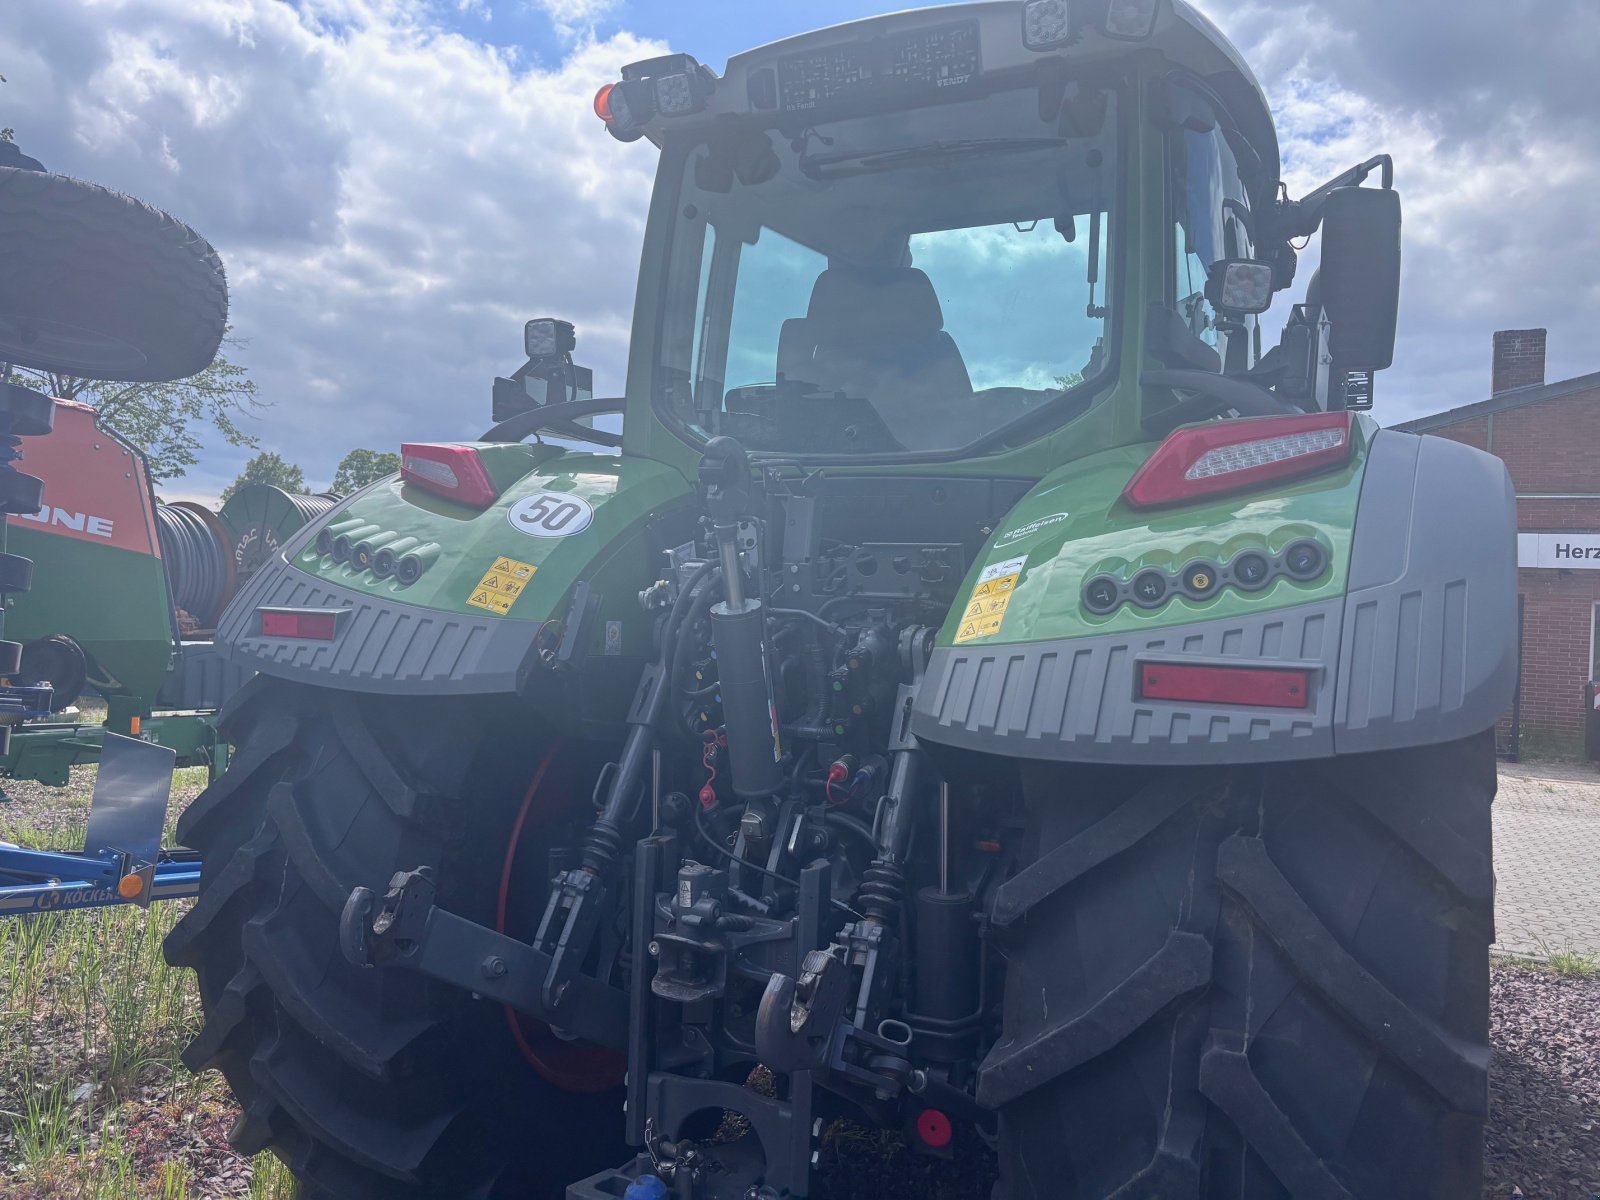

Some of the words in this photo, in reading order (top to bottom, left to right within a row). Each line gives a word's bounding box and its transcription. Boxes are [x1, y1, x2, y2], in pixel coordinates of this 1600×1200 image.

[936, 74, 971, 88] FENDT
[519, 495, 582, 531] 50
[1013, 516, 1062, 535] Raiffeisen
